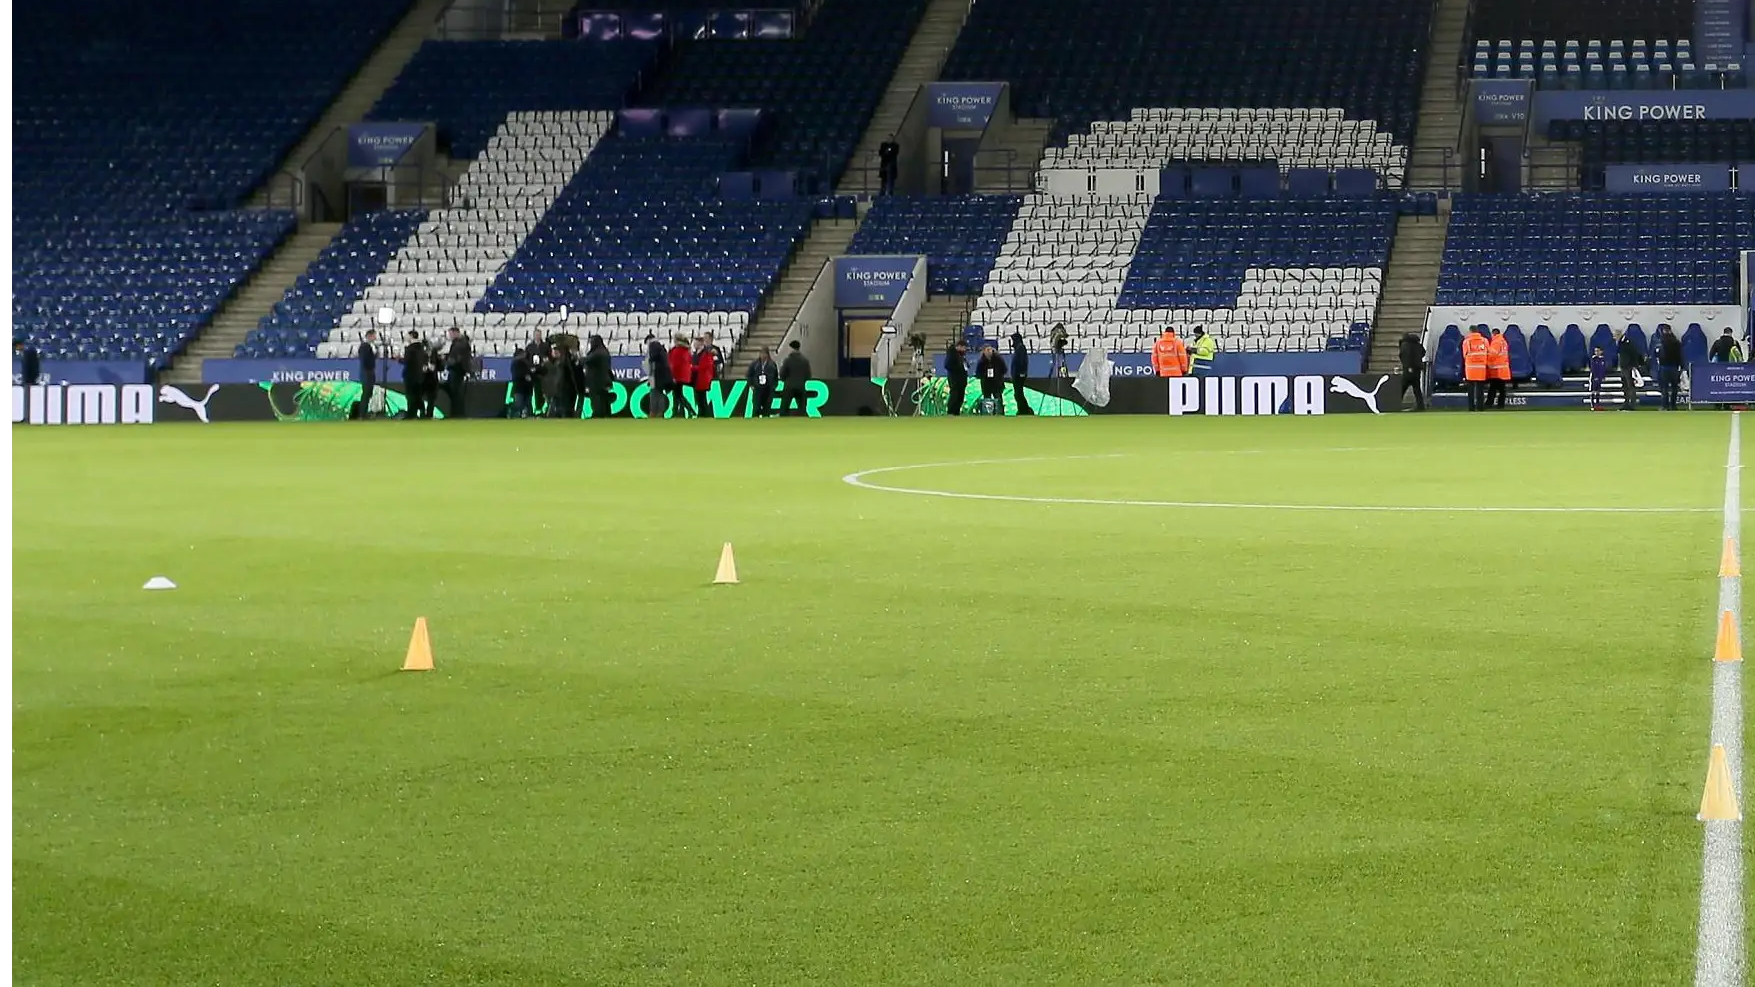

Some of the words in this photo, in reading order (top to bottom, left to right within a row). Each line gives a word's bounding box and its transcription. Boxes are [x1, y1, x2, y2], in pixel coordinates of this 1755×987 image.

[937, 96, 959, 105] KING
[961, 96, 992, 105] POWER
[1584, 105, 1632, 120] KING
[1639, 104, 1706, 120] POWER
[1633, 174, 1661, 184] KING
[1663, 174, 1701, 183] POWER
[846, 271, 870, 281] KING
[873, 271, 907, 281] POWER
[272, 370, 304, 382] KING
[307, 370, 350, 382] POWER
[611, 368, 641, 380] WER
[1111, 365, 1133, 376] ING
[1710, 374, 1731, 382] KING
[1168, 375, 1325, 415] PUMA
